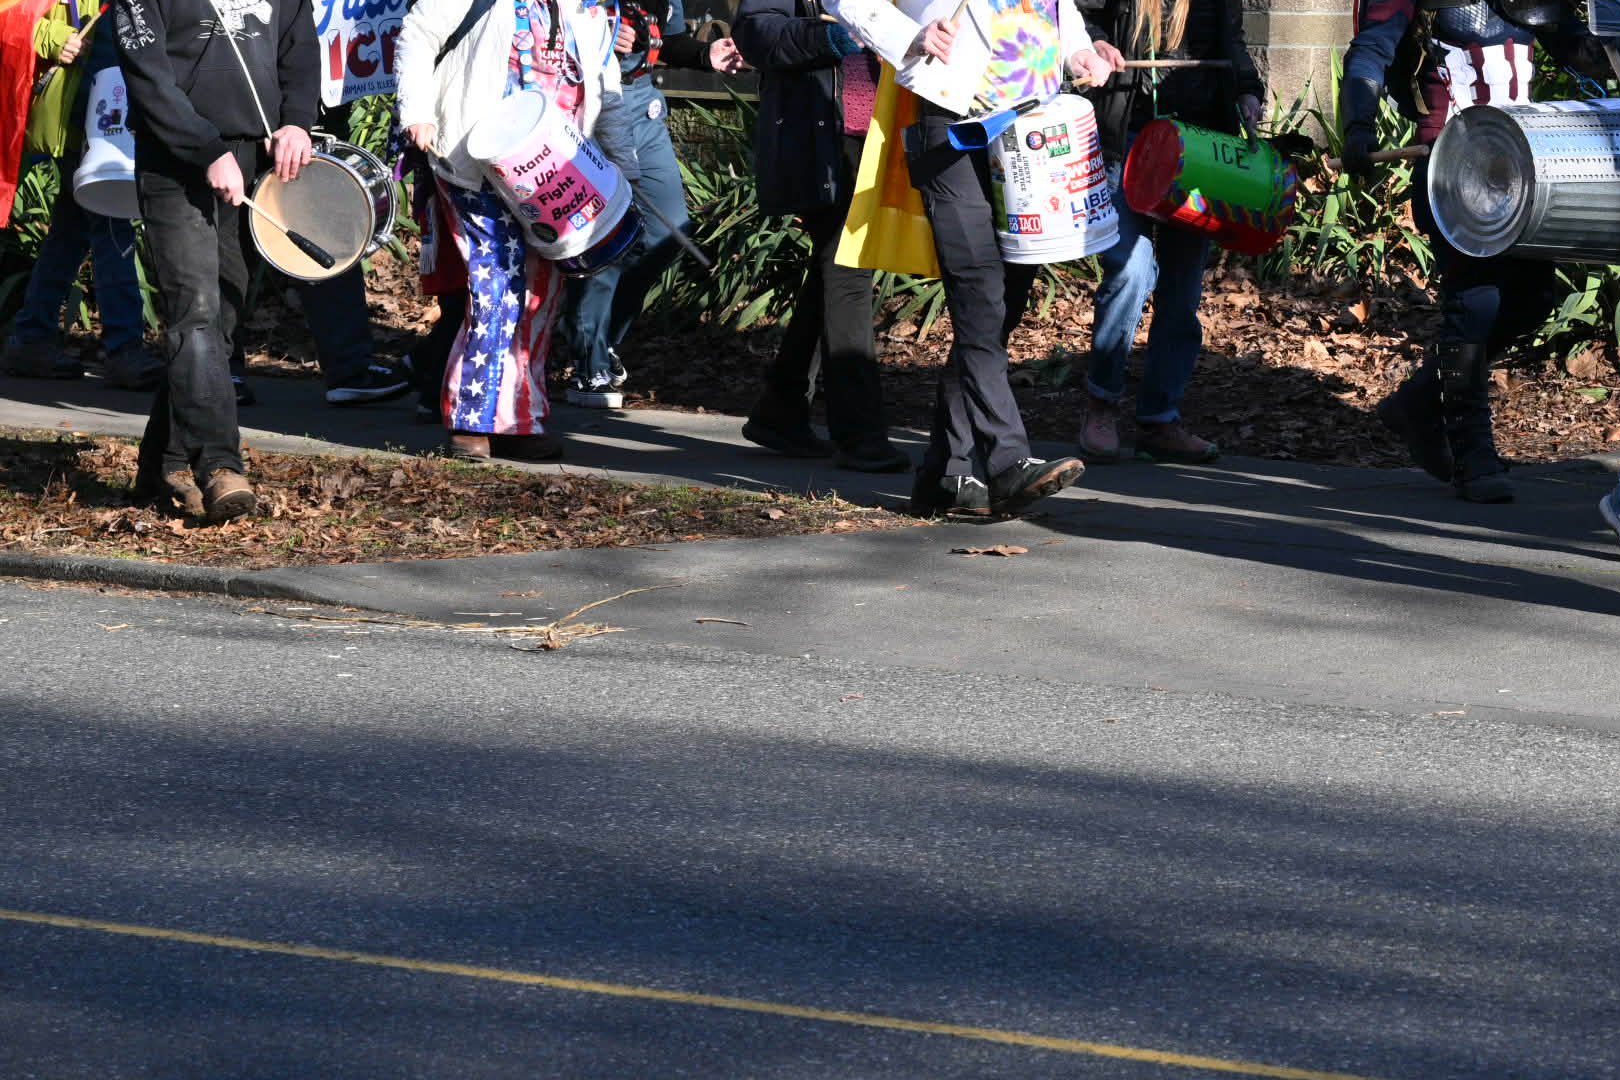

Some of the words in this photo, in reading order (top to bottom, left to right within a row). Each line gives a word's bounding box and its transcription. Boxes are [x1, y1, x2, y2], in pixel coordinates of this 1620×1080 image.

[513, 144, 552, 176] Stand
[1212, 142, 1250, 170] ICE
[535, 162, 559, 187] Up!
[538, 176, 575, 206] Fight
[551, 185, 588, 220] Back!
[1071, 186, 1111, 214] LIBE
[1018, 216, 1041, 232] TACO
